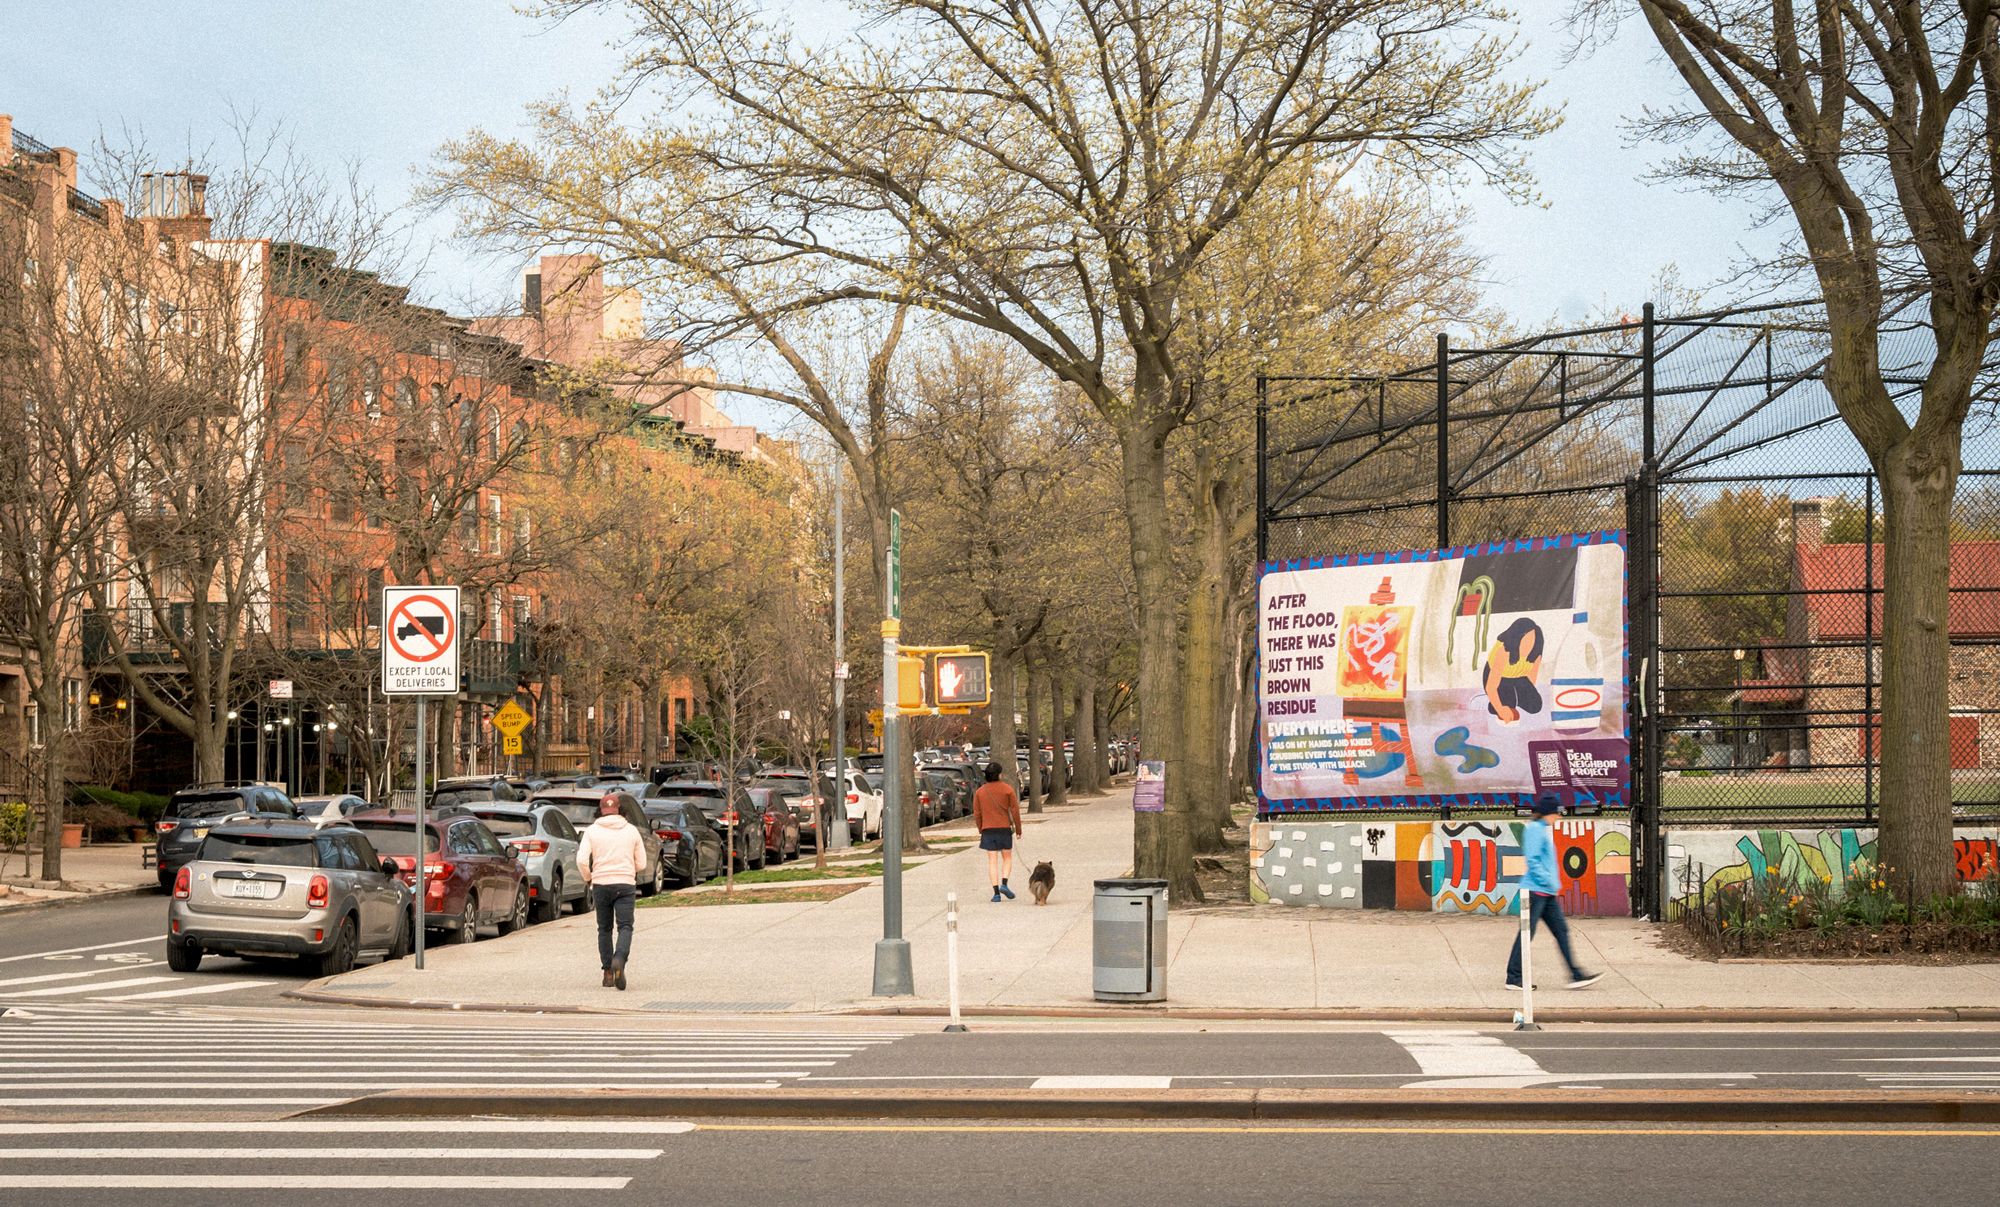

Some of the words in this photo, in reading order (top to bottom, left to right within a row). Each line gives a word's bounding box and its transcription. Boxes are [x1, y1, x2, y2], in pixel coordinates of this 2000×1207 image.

[1268, 593, 1306, 610] AFTER
[1267, 615, 1289, 631] THE
[1292, 612, 1338, 629] FLOOD,
[1267, 635, 1303, 652] THERE
[1307, 633, 1336, 649] WAS
[1267, 657, 1292, 673] JUST
[1296, 655, 1324, 671] THIS
[389, 666, 421, 676] EXCEPT
[424, 666, 452, 676] LOCAL
[396, 678, 446, 688] DELIVERIES
[1267, 678, 1311, 694] BROWN
[1267, 699, 1317, 715] RESIDUE
[500, 712, 522, 720] SPEED
[502, 720, 520, 728] BUMP
[506, 737, 518, 747] 15
[1272, 741, 1284, 749] WAS
[1285, 741, 1295, 749] ON
[1296, 740, 1307, 749] MY
[1308, 739, 1332, 748] HANDS
[1333, 738, 1349, 747] AND
[1350, 737, 1373, 746] KNEES
[1304, 750, 1327, 759] EVERY
[1328, 749, 1357, 758] SQUARE
[1357, 748, 1376, 757] INCH
[1567, 752, 1593, 761] DEAR
[1269, 763, 1278, 771] OF
[1279, 762, 1292, 771] THE
[1292, 761, 1318, 770] STUDIO
[1319, 760, 1337, 769] WITH
[1569, 760, 1618, 768] NEIGHBOR
[1570, 767, 1609, 777] PROJECT
